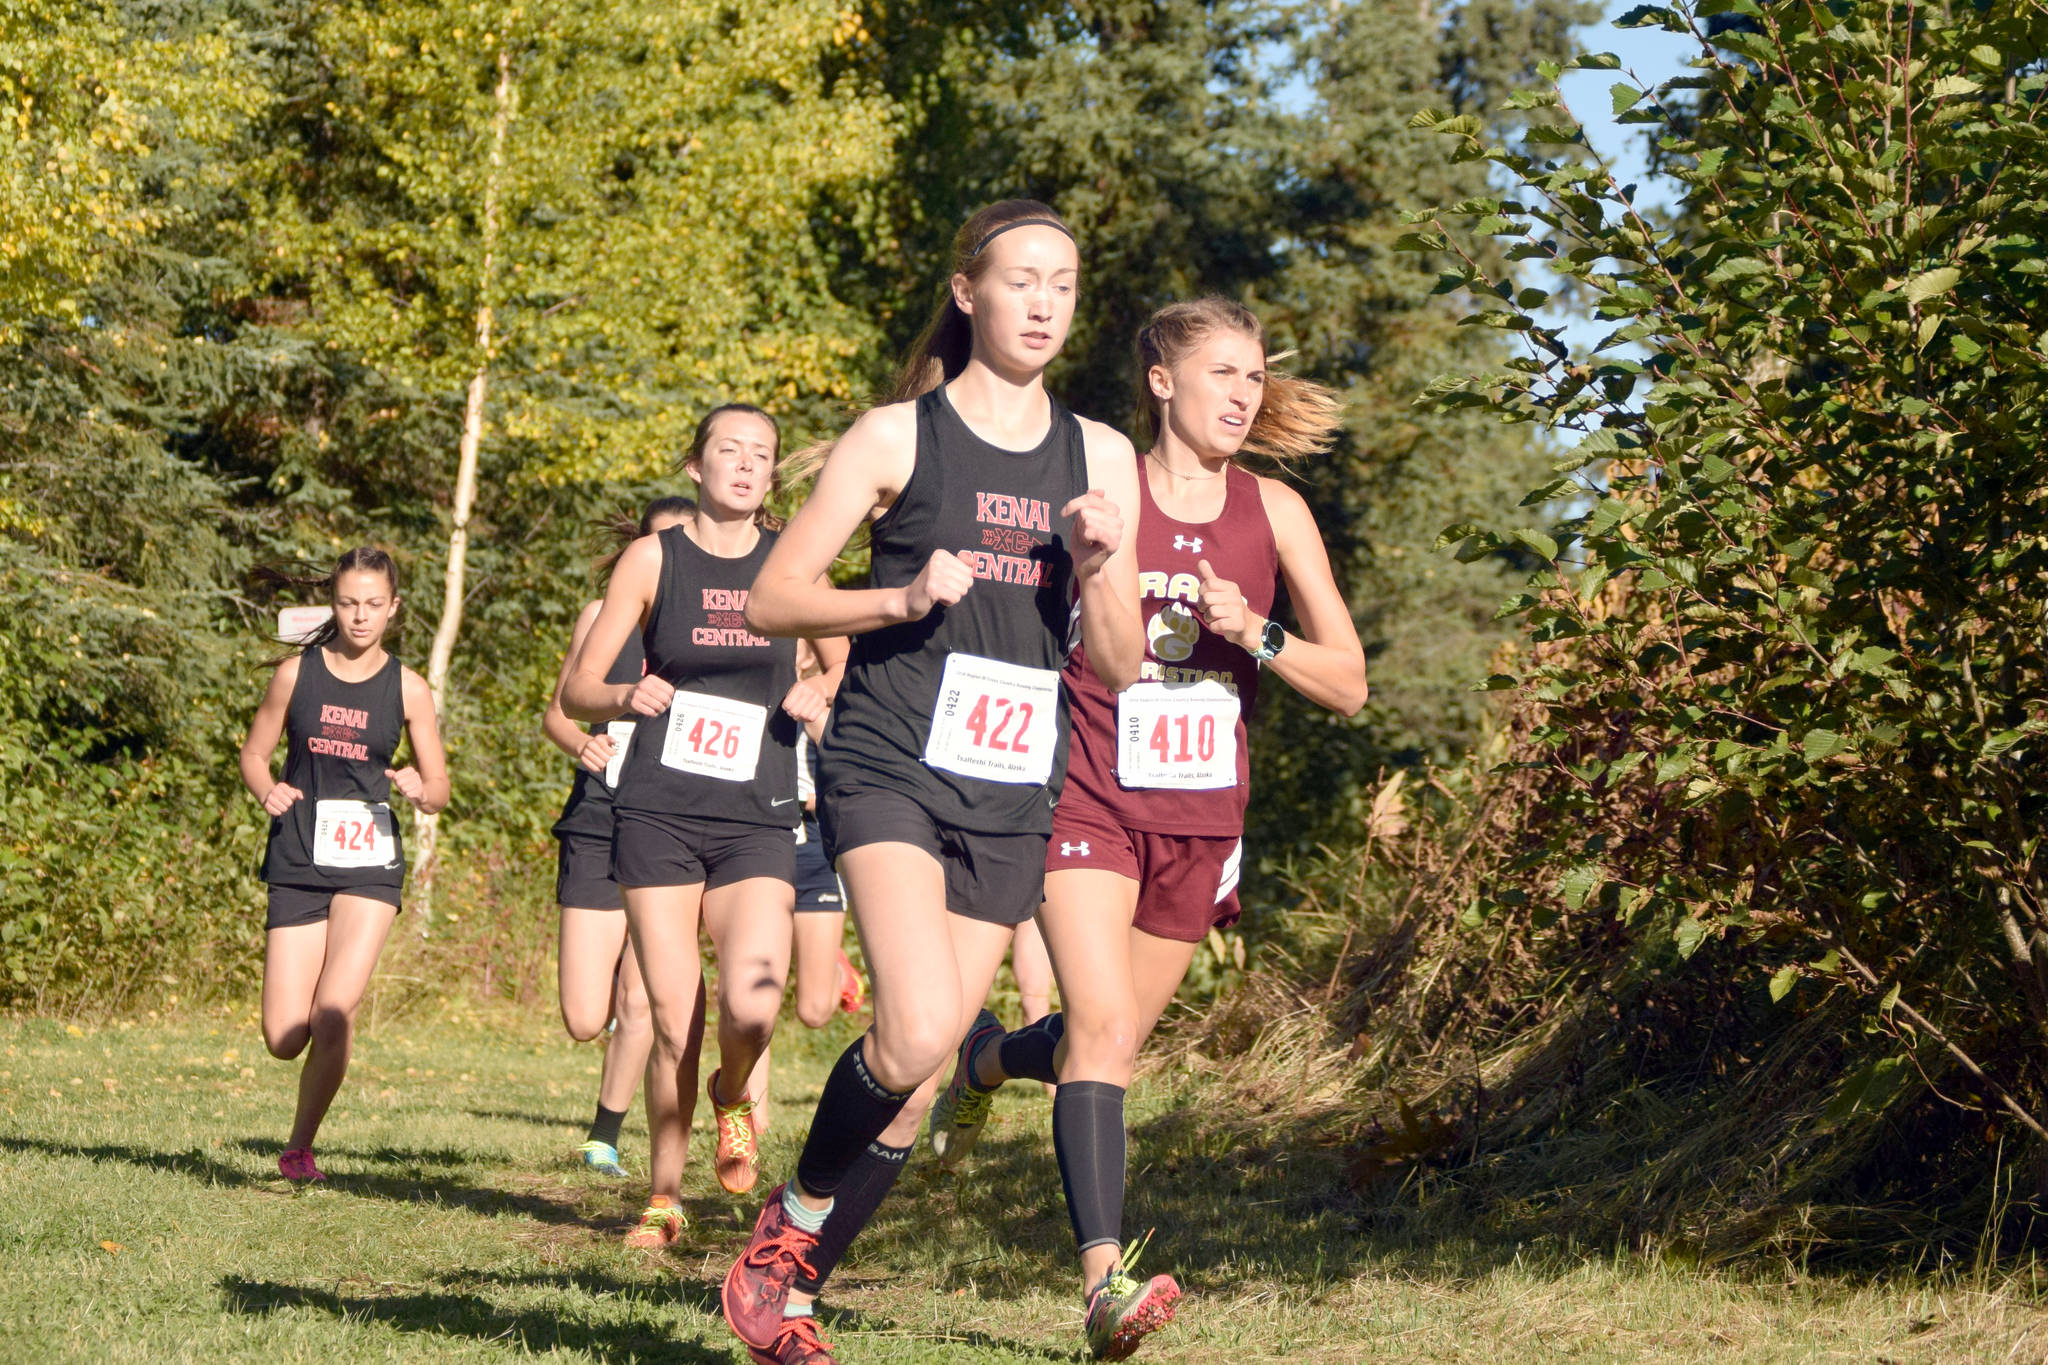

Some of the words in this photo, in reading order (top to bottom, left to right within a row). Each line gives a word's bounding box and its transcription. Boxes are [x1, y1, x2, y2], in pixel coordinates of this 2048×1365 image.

[976, 491, 1051, 532] KENAI
[702, 588, 749, 611] KENA
[1141, 661, 1235, 686] RISTIAN
[944, 689, 961, 717] 0422
[320, 704, 369, 729] KENAI
[675, 713, 685, 732] 0426
[965, 694, 1034, 754] 422
[1129, 716, 1140, 742] 0410
[307, 736, 369, 762] CENTRAL
[688, 717, 741, 759] 426
[1149, 714, 1215, 763] 410
[333, 820, 375, 851] 424
[867, 1143, 905, 1160] SAH
